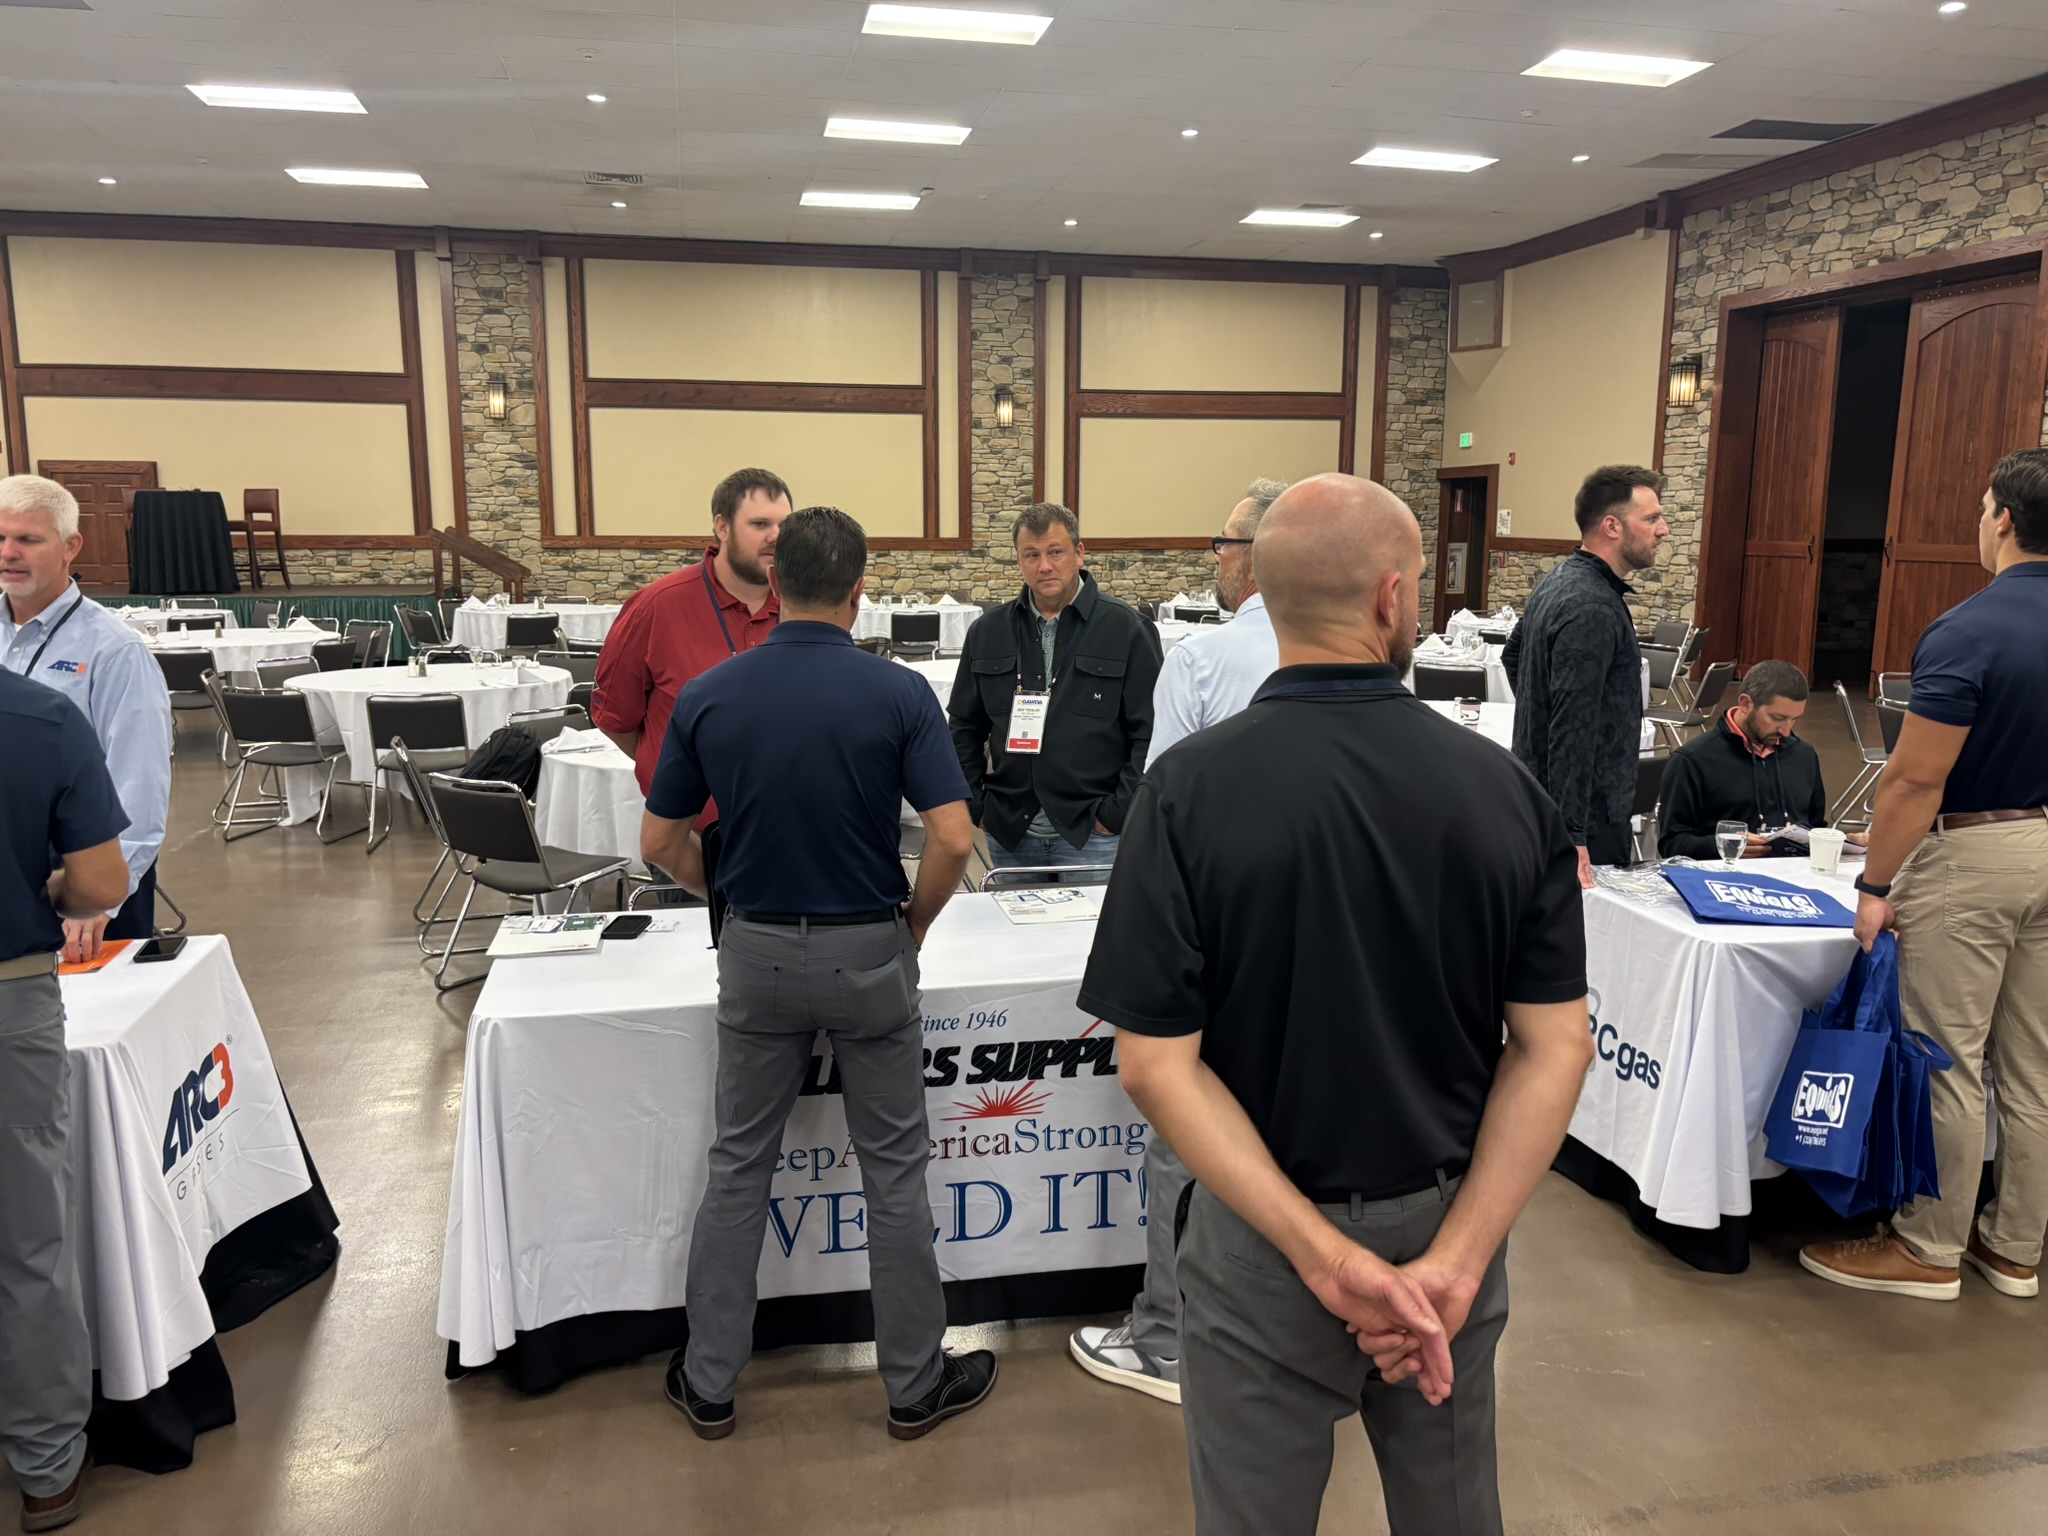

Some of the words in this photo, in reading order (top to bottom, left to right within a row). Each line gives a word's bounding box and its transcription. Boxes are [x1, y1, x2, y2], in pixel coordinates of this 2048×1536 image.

[921, 1014, 960, 1032] ince
[965, 1008, 1009, 1031] 1946
[965, 1036, 1119, 1085] SUPPL
[162, 1042, 234, 1177] ARC3
[1040, 1166, 1148, 1234] IT!
